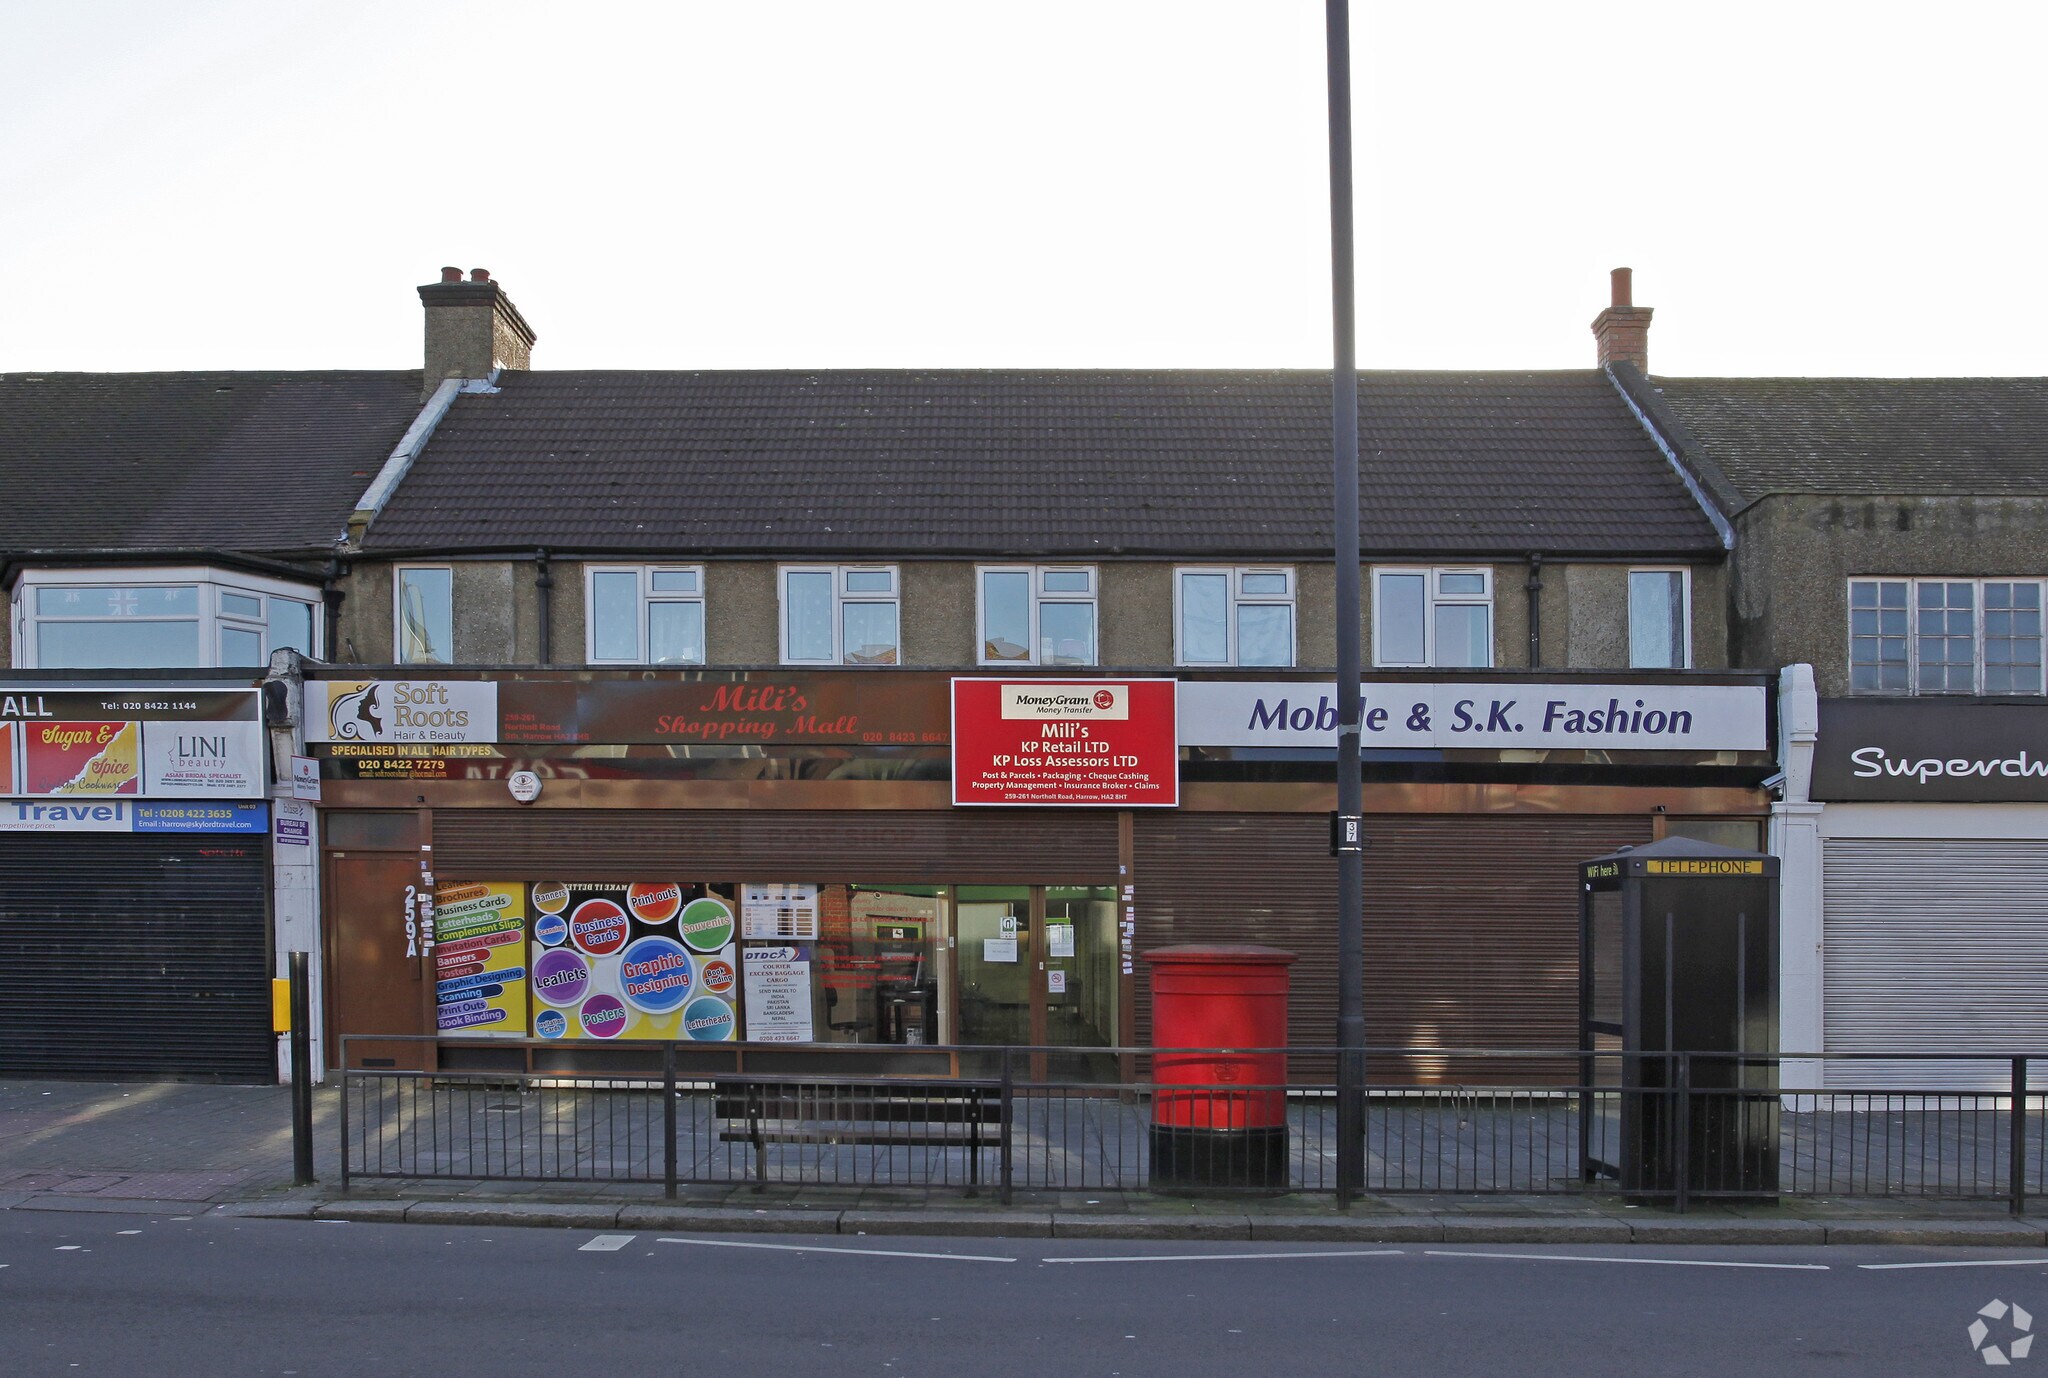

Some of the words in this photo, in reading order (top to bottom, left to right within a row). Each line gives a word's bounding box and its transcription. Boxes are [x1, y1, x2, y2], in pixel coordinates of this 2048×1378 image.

[394, 682, 448, 704] Soft
[700, 685, 808, 712] Mili's
[1016, 695, 1089, 706] MoneyGram
[1, 696, 53, 717] ALL
[101, 702, 120, 710] Tel:
[122, 702, 141, 710] 020
[144, 702, 168, 710] 8422
[172, 702, 196, 710] 1144
[1036, 707, 1062, 716] Money
[394, 705, 468, 728] Roots
[1248, 696, 1388, 732] Moble
[1406, 702, 1432, 732] &
[1451, 700, 1524, 733] S.K.
[1542, 698, 1693, 734] Fashion
[654, 716, 777, 740] Shopping
[786, 716, 858, 735] Mall
[1042, 722, 1089, 738] Mili's
[42, 725, 92, 751] Sugar
[96, 725, 113, 744] &
[394, 731, 415, 740] Hair
[418, 731, 426, 740] &
[430, 731, 466, 742] Beauty
[863, 732, 882, 742] 020
[889, 732, 916, 742] 8423
[922, 732, 948, 742] 6647
[178, 736, 226, 758] LINI
[332, 746, 395, 756] SPECIALISED
[398, 746, 408, 756] IN
[411, 746, 430, 756] ALL
[432, 746, 456, 756] HAIR
[459, 746, 491, 756] TYPES
[1022, 742, 1038, 752] KP
[1042, 740, 1080, 752] Retail
[1085, 742, 1110, 752] LTD
[92, 758, 130, 778] Spice
[179, 758, 226, 768] beauty
[358, 760, 380, 769] 020
[384, 760, 412, 769] 8422
[416, 760, 445, 769] 7279
[993, 756, 1010, 767] KP
[1014, 756, 1042, 767] Loss
[1045, 756, 1110, 767] Assessors
[1114, 756, 1138, 767] LTD
[1043, 772, 1082, 781] Packaging
[1089, 772, 1117, 780] Cheque
[1119, 772, 1148, 781] Cashing
[972, 782, 1004, 790] Property
[1006, 782, 1057, 790] Management
[11, 802, 122, 821] Travel
[160, 809, 184, 818] 0208
[186, 809, 205, 818] 422
[208, 809, 232, 818] 3635
[162, 821, 252, 829] harrow@skylordtravel.com
[1587, 866, 1599, 877] WiFi
[1600, 866, 1612, 876] here
[1657, 861, 1752, 873] TELEPHONE
[436, 888, 484, 904] Brochures
[535, 889, 567, 902] Banners
[632, 894, 655, 907] Print
[657, 888, 677, 900] outs
[437, 901, 477, 916] Business
[479, 897, 506, 908] Cards
[436, 912, 493, 930] Letterheads
[436, 923, 497, 940] Complement
[499, 917, 521, 931] Slips
[574, 915, 624, 934] Business
[683, 916, 730, 934] Souvenirs
[437, 939, 482, 954] Invitation
[484, 933, 511, 946] Cards
[586, 930, 619, 945] Cards
[437, 953, 476, 966] Banners
[624, 954, 684, 977] Graphic
[438, 967, 473, 980] Posters
[438, 978, 473, 991] Graphic
[475, 968, 522, 983] Designing
[535, 968, 587, 989] Leaflets
[706, 968, 725, 976] Book
[628, 974, 690, 995] Designing
[706, 975, 733, 985] Binding
[438, 988, 483, 1002] Scanning
[438, 1006, 461, 1016] Print
[463, 1001, 486, 1012] Outs
[438, 1016, 463, 1028] Book
[465, 1010, 501, 1023] Binding
[583, 1008, 625, 1026] Posters
[686, 1014, 731, 1029] Letterheads
